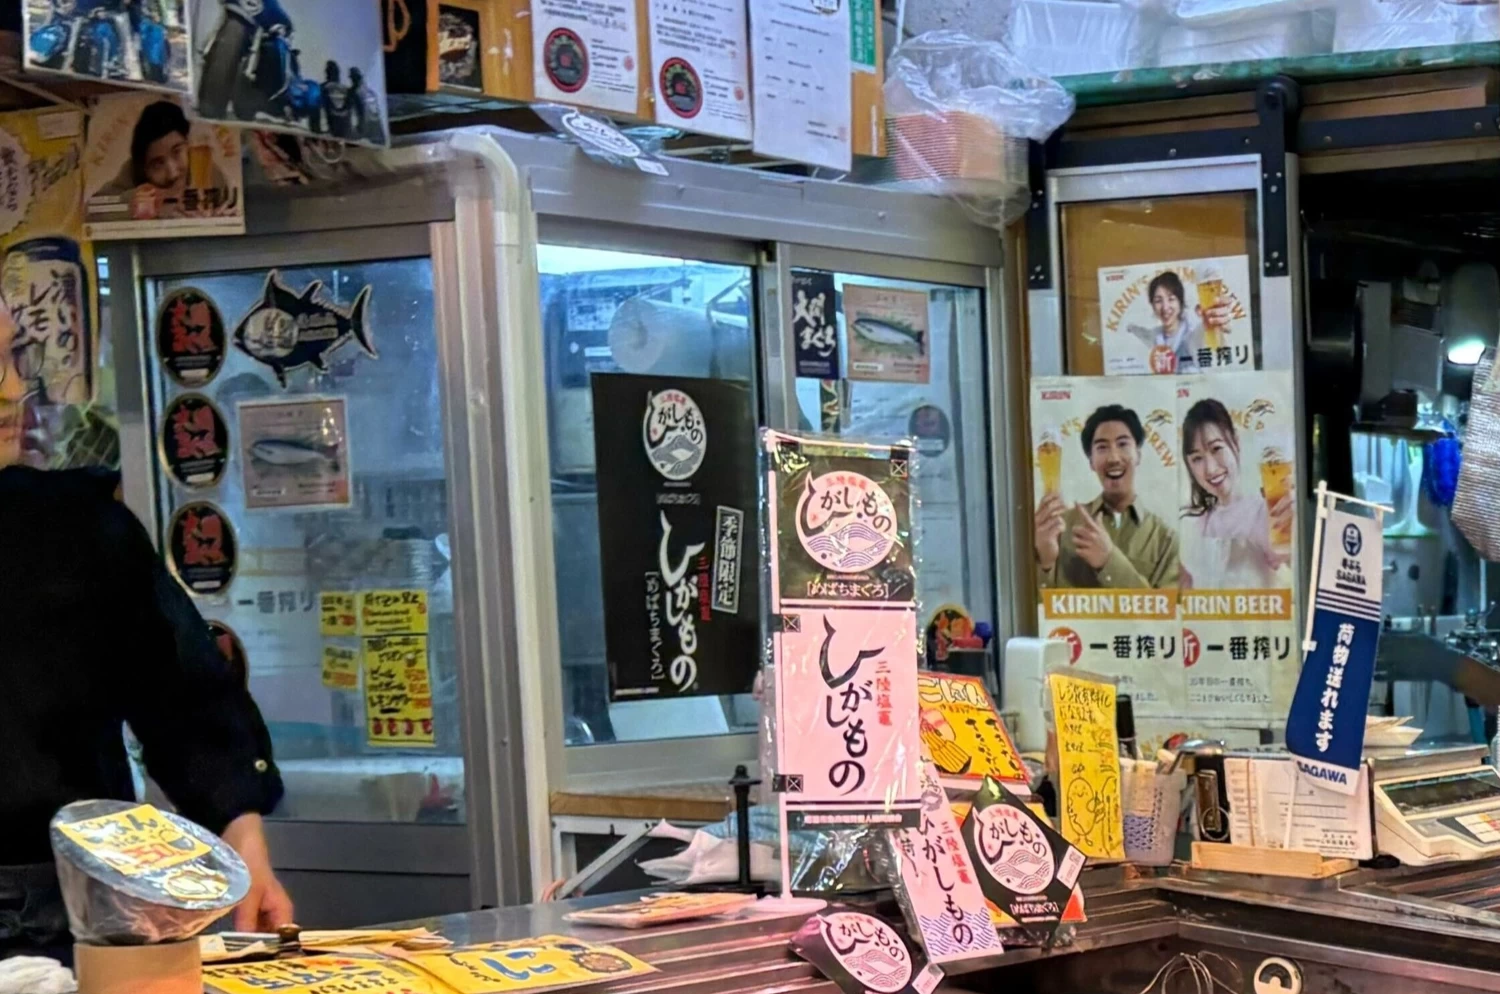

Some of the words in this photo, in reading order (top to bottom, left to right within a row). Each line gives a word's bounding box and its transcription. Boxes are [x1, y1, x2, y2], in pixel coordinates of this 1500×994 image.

[1179, 345, 1249, 368] 一番搾り
[1041, 390, 1071, 400] KIRIN
[658, 510, 706, 694] ひがしもの
[1051, 594, 1114, 616] KIRIN
[1118, 594, 1171, 616] BEER
[1235, 595, 1285, 616] BEER
[1089, 634, 1176, 660] 一番搾り
[1207, 635, 1291, 661] 一番搾り
[1314, 622, 1356, 753] 荷物送れます
[819, 613, 886, 796] ひがしもの
[917, 813, 974, 945] ひがしもの
